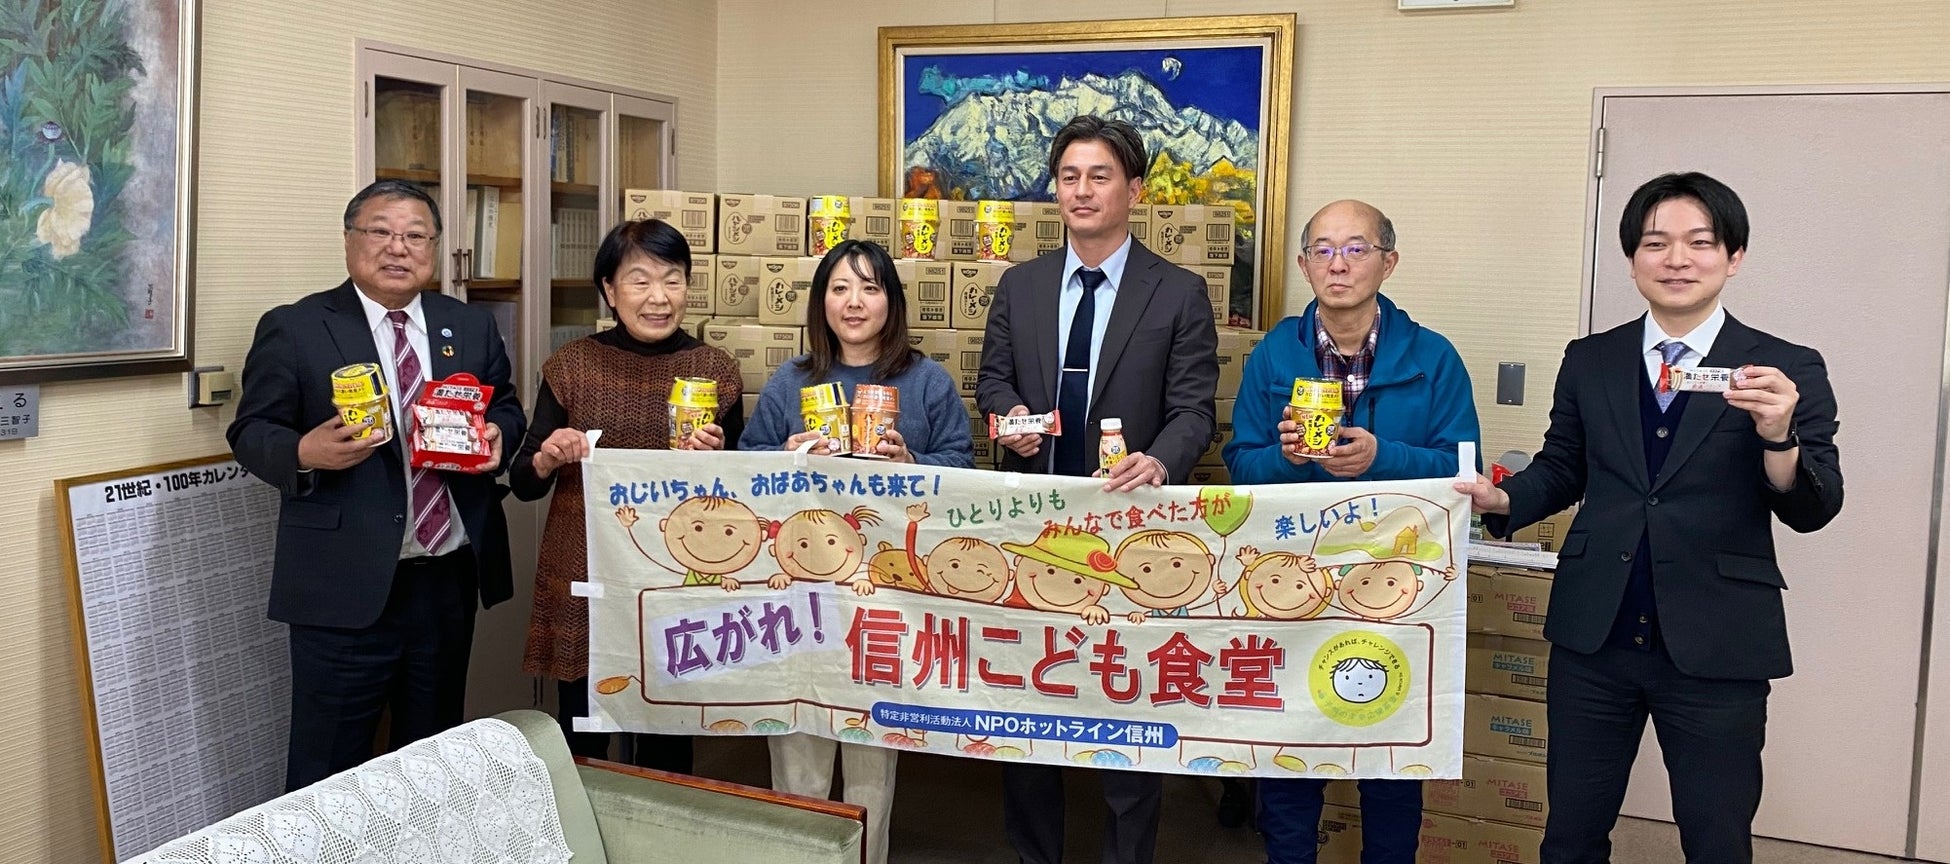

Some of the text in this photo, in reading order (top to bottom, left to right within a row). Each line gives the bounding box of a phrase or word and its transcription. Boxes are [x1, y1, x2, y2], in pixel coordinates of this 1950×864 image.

[1312, 414, 1325, 446] カレーメシ
[947, 488, 1066, 527] ひとりよりも
[1042, 494, 1231, 538] みんなで食べた方が
[1495, 592, 1536, 605] MITASE
[845, 605, 1285, 712] 信州こども食堂
[1493, 653, 1535, 666] MITASE
[880, 708, 1164, 745] 特定非営利活動法人 NPOホットライン信州
[1491, 715, 1532, 728] MITASE
[1487, 779, 1528, 790] MITASE
[1478, 840, 1519, 853] MITASE
